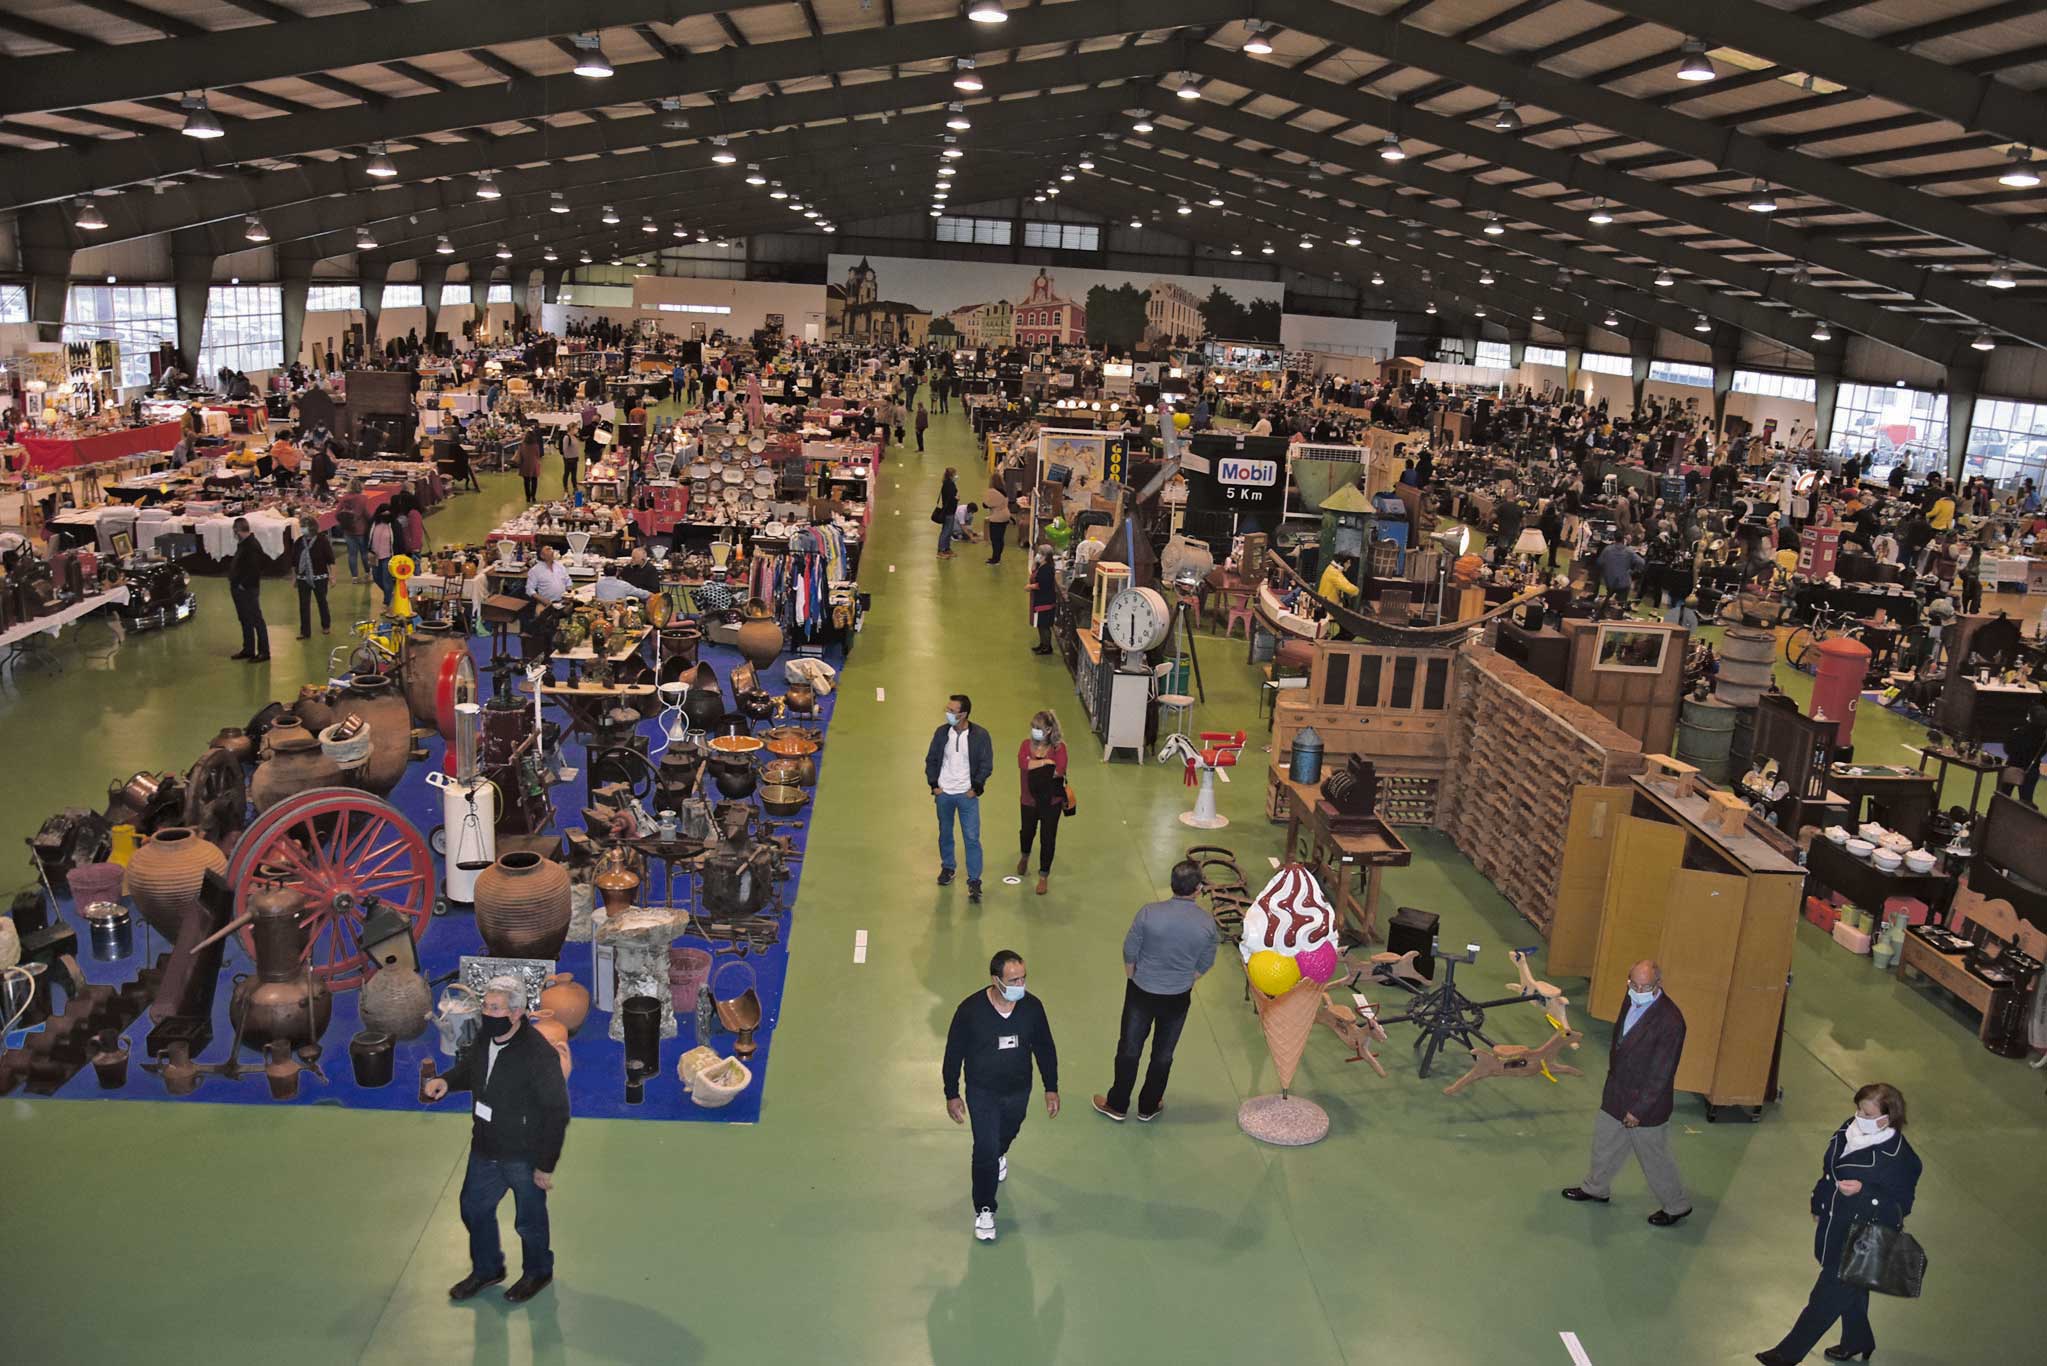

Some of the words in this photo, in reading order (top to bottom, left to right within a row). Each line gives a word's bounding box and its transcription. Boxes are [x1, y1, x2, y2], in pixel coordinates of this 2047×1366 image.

[1222, 463, 1273, 482] Mobil
[1226, 488, 1236, 499] 5
[1240, 488, 1263, 500] Km
